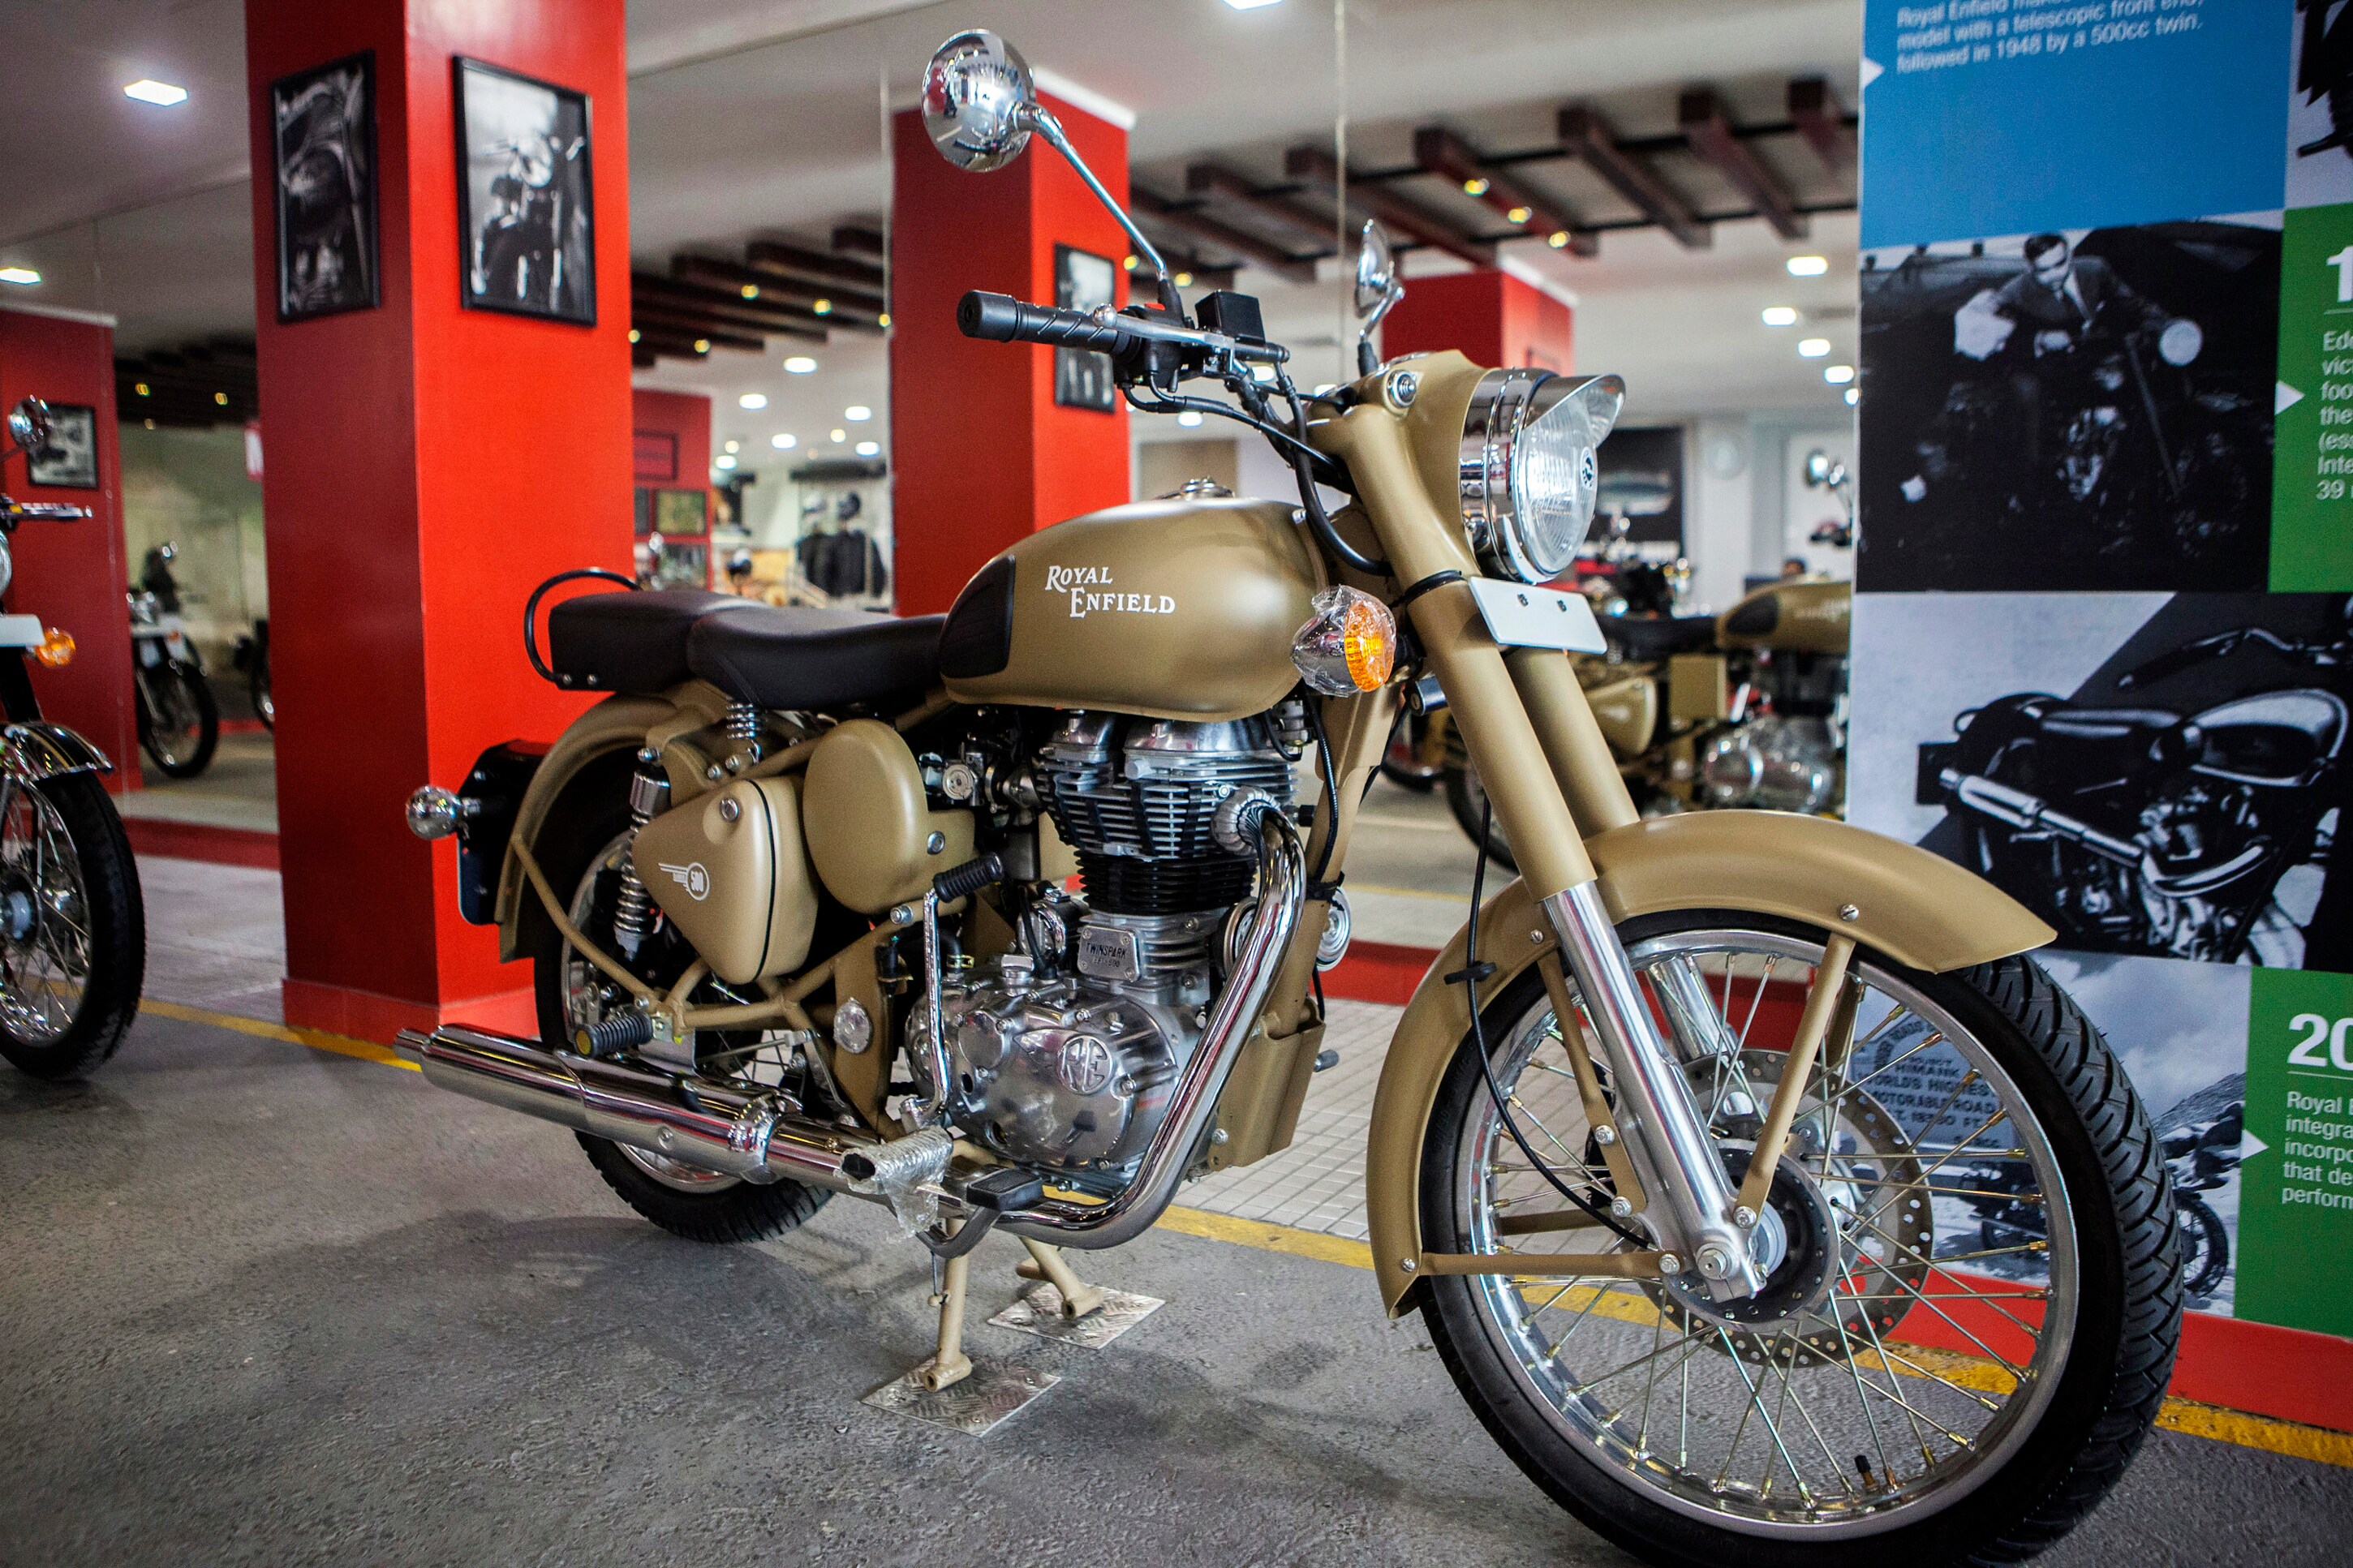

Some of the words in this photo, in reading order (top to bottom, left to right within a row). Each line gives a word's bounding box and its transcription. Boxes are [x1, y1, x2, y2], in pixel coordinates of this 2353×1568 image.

[1897, 4, 1946, 29] Royal
[1948, 0, 2009, 20] Enfield
[1897, 25, 1951, 50] model
[1955, 19, 1993, 41] with
[1997, 18, 2009, 37] a
[2014, 3, 2106, 33] telescopic
[1897, 45, 1970, 75] followed
[1972, 44, 1991, 62] in
[1998, 33, 2042, 58] 1948
[2046, 31, 2069, 54] by
[2073, 30, 2086, 48] a
[2090, 20, 2151, 45] 500cc
[2316, 479, 2345, 500] 39
[1045, 565, 1113, 593] ROYAL
[1069, 586, 1176, 618] ENFIELD
[1086, 943, 1128, 960] TWINSPARK
[1928, 1079, 1996, 1098] HIGES
[2286, 1091, 2342, 1115] Royal
[2283, 1161, 2322, 1182] that
